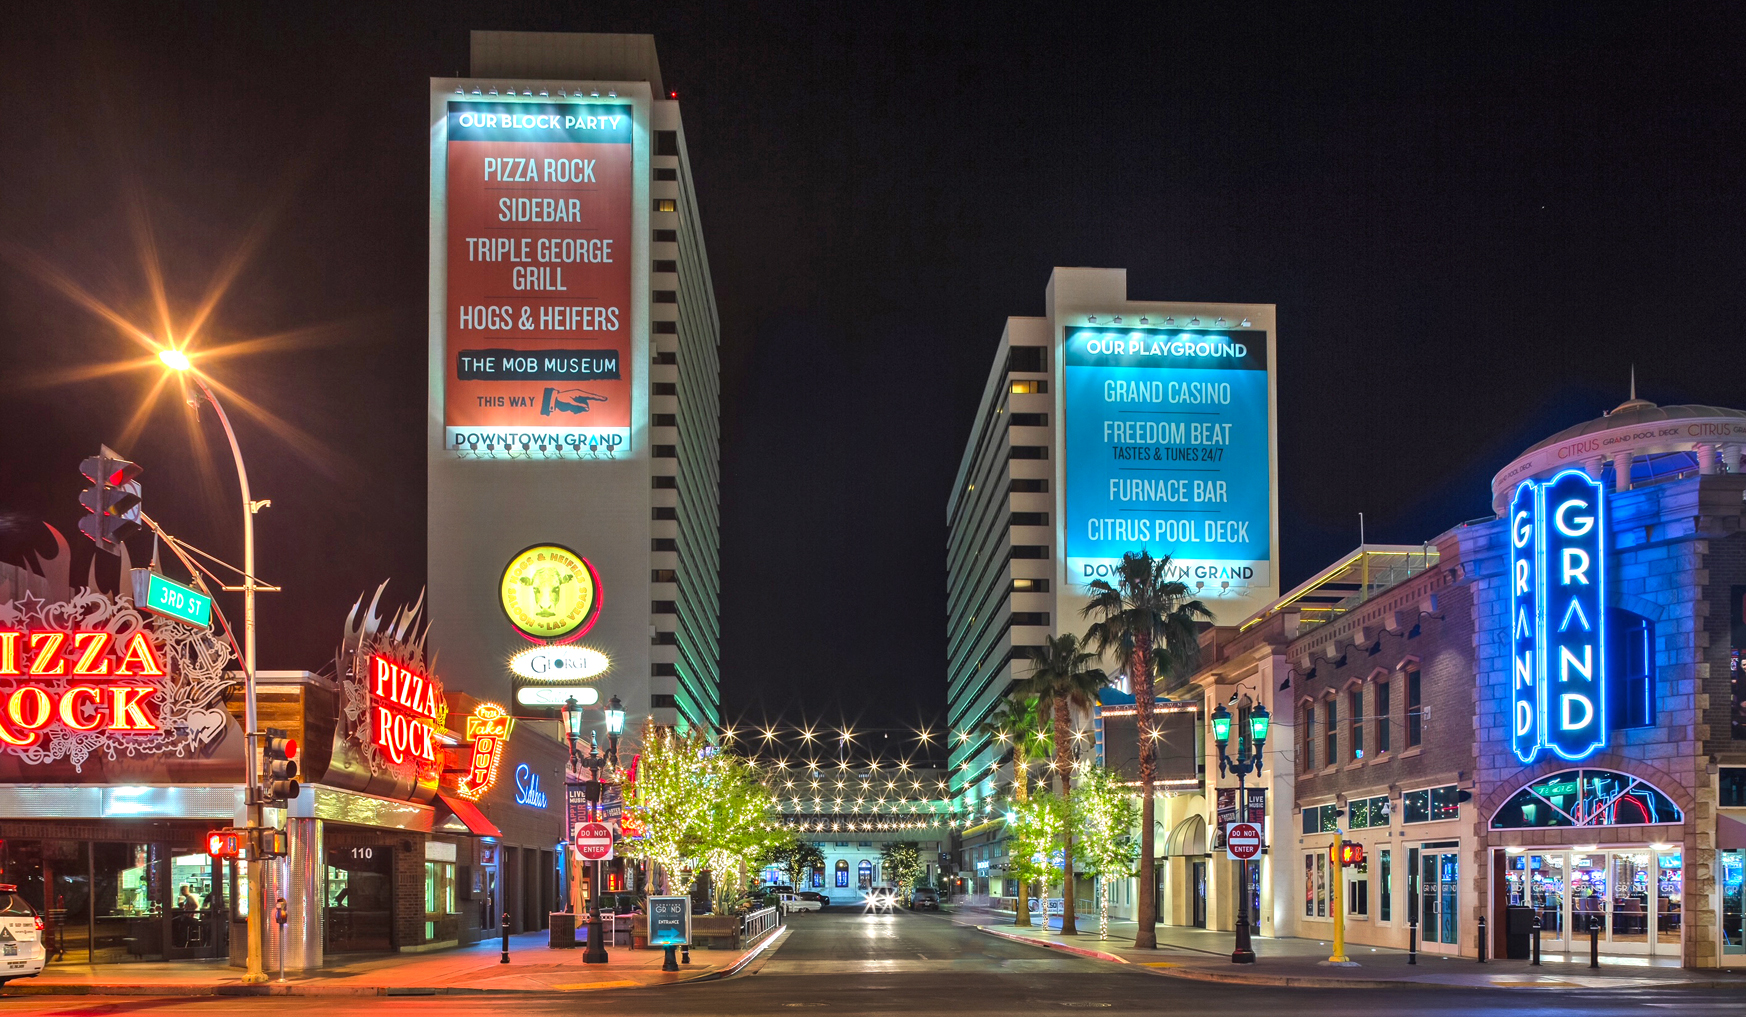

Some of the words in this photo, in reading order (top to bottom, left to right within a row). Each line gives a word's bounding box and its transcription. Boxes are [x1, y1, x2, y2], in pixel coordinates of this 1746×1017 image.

[459, 114, 497, 128] OUR
[501, 114, 561, 129] BLOCK
[565, 116, 621, 130] PARTY
[484, 158, 538, 182] PIZZA
[544, 159, 596, 183] ROCK
[498, 198, 581, 222] SIDEBAR
[466, 238, 532, 262] TRIPLE
[537, 238, 613, 263] GEORGE
[512, 266, 567, 291] GRILL
[460, 305, 513, 330] HOGS
[518, 306, 535, 330] &
[540, 306, 619, 331] HEIFERS
[1086, 340, 1124, 355] OUR
[1129, 341, 1247, 358] PLAYGROUND
[461, 357, 495, 372] THE
[503, 358, 538, 372] MOB
[544, 358, 616, 373] MUSEUM
[477, 396, 505, 407] THIS
[509, 396, 535, 407] WAY
[1104, 380, 1163, 403] GRAND
[1168, 381, 1231, 405] CASINO
[455, 433, 560, 446] DOWNTOWN
[564, 434, 622, 446] GRAND
[1104, 421, 1185, 444] FREEDOM
[1191, 423, 1232, 445] BEAT
[1558, 439, 1600, 459] CITRUS
[1603, 435, 1631, 446] GRAND
[1633, 431, 1656, 440] POOL
[1658, 428, 1679, 436] DECK
[1688, 423, 1731, 437] CITRUS
[1112, 446, 1150, 460] TASTES
[1153, 447, 1162, 461] &
[1165, 447, 1199, 461] TUNES
[1201, 448, 1224, 462] 24/7
[1520, 462, 1533, 472] DECK
[1109, 478, 1188, 502] FURNACE
[1194, 480, 1227, 502] BAR
[1087, 518, 1150, 541] CITRUS
[1155, 520, 1200, 542] POOL
[1205, 520, 1250, 543] DECK
[510, 557, 534, 584] HOGS
[537, 553, 546, 561] &
[550, 553, 585, 583] HEIFERS
[1084, 564, 1190, 579] DOWWN
[1195, 566, 1254, 580] GRAND
[160, 586, 184, 608] 3RD
[188, 599, 202, 616] ST
[508, 588, 535, 627] SALOON
[546, 619, 566, 630] LAS
[567, 587, 587, 620] VEGAS
[1513, 510, 1532, 736] GRAND
[1554, 499, 1594, 731] GRAND
[376, 657, 436, 719] PIZZA
[0, 686, 157, 746] OCK
[470, 720, 504, 735] Take
[379, 706, 435, 764] ROCK
[475, 738, 492, 783] OUT
[578, 804, 586, 821] OUR
[352, 848, 373, 859] 110
